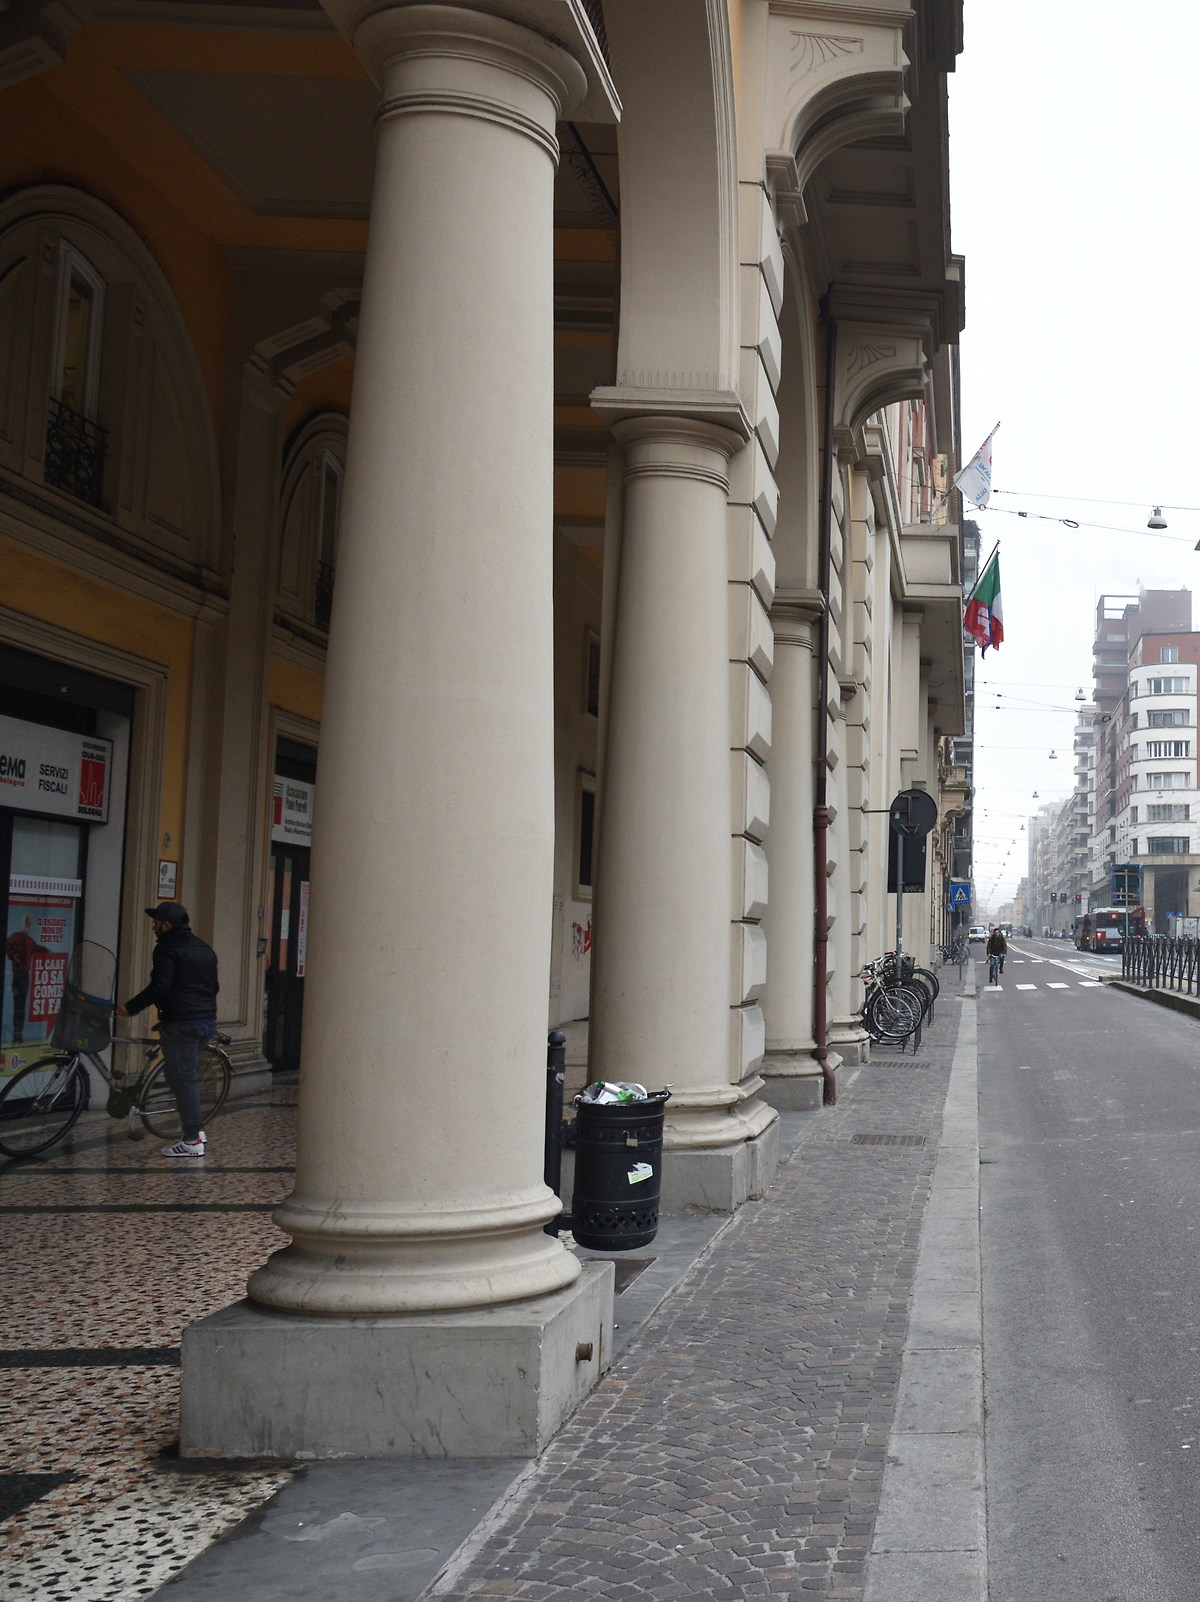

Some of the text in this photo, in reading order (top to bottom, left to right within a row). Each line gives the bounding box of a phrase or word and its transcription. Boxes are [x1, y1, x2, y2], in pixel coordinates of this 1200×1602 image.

[40, 763, 69, 780] SERVIZI
[38, 779, 68, 795] FISCALI
[35, 959, 65, 970] IL CAAF
[34, 970, 64, 985] LO SA
[34, 985, 65, 999] COME
[32, 998, 61, 1015] SI FA
